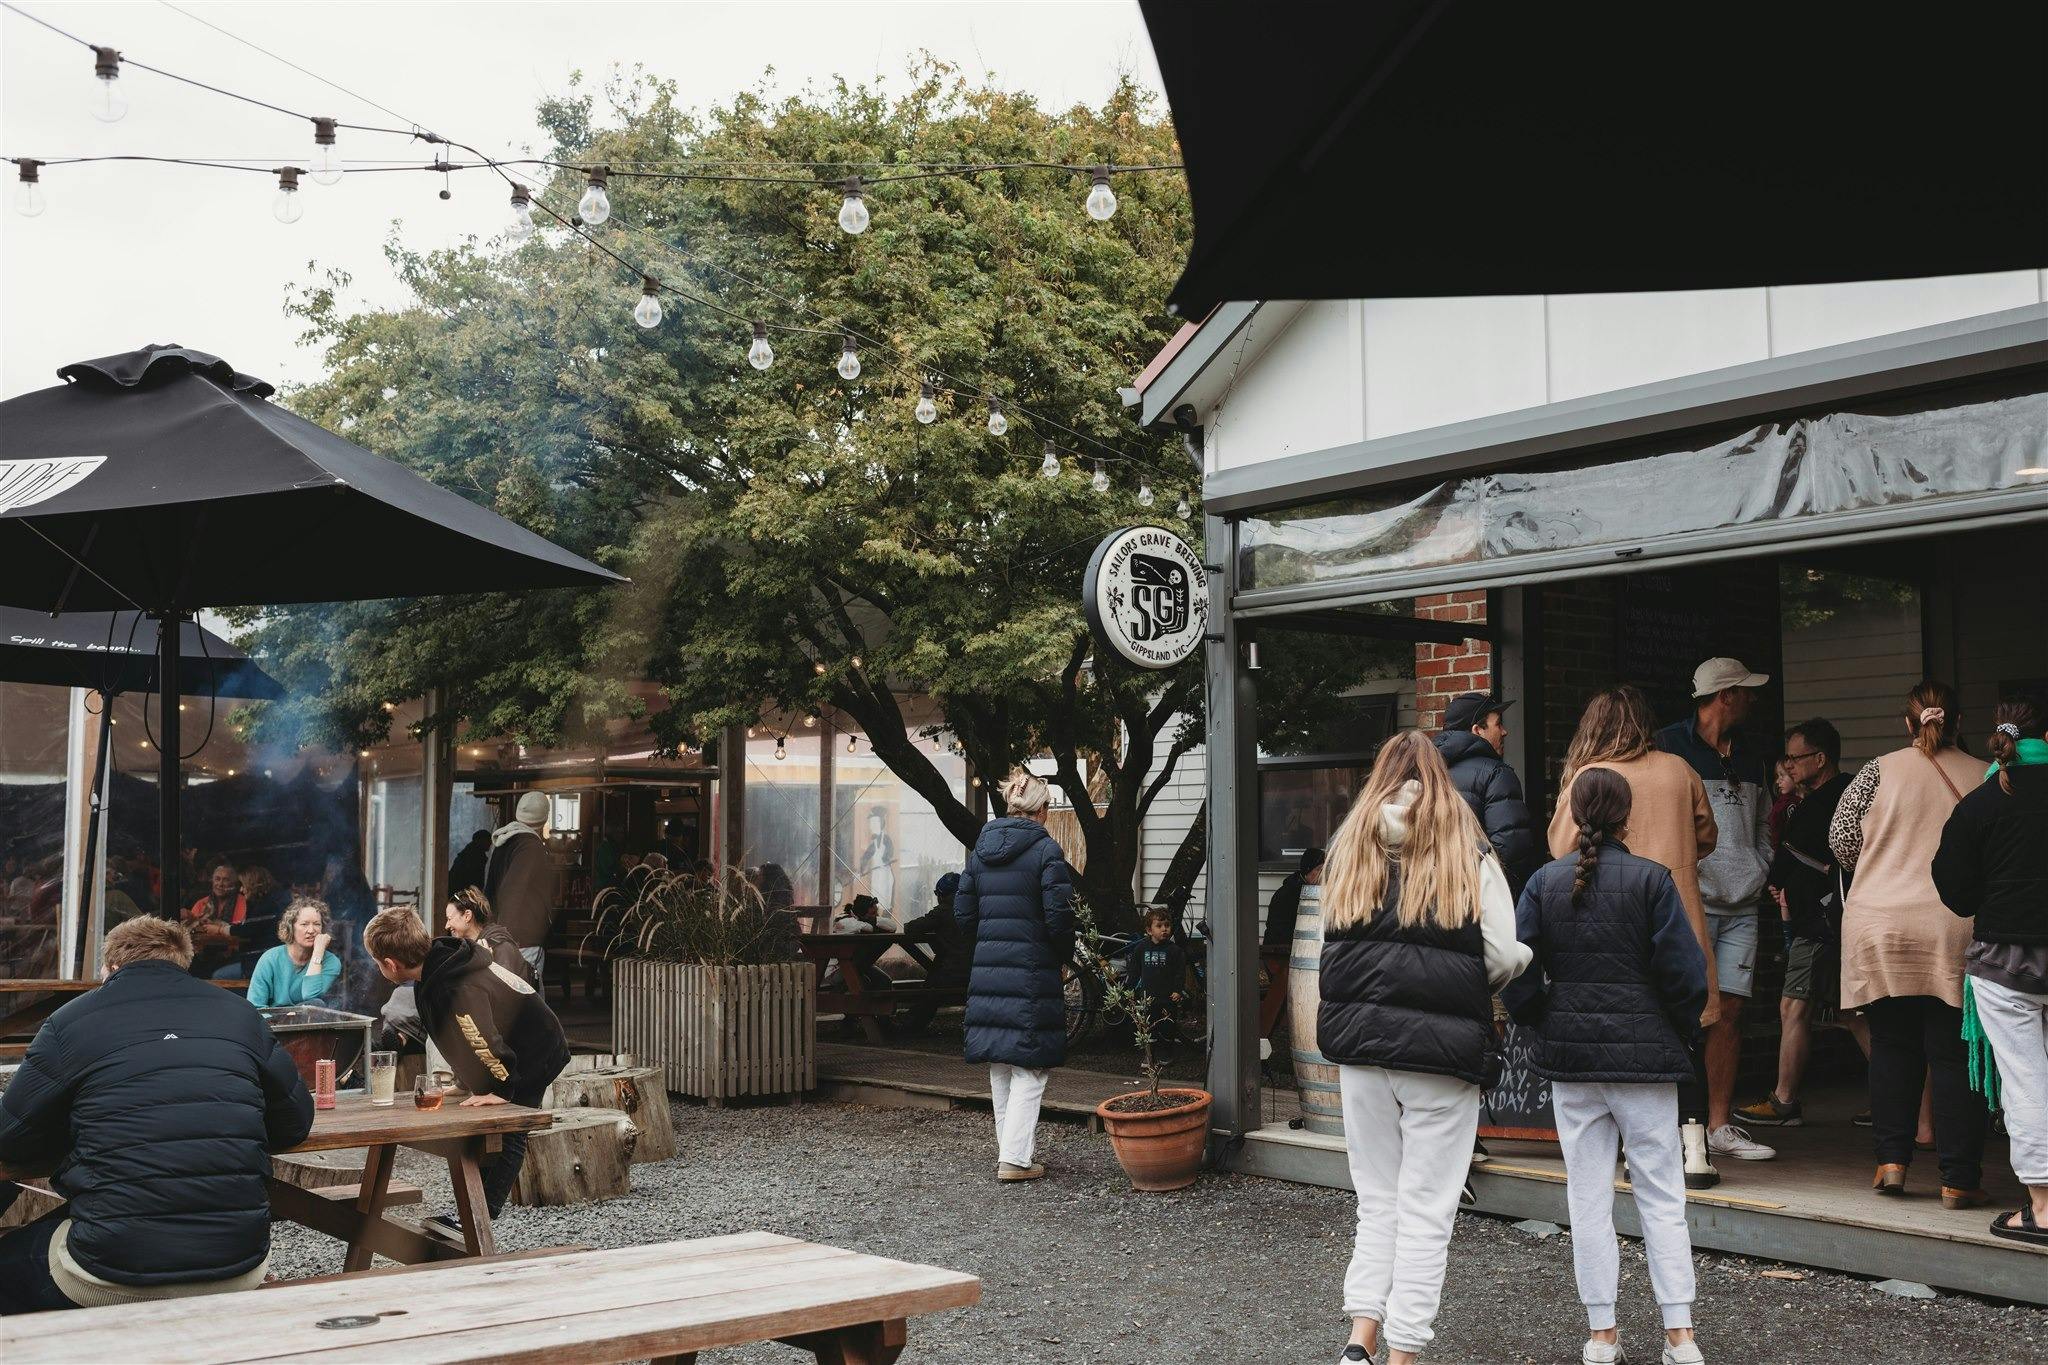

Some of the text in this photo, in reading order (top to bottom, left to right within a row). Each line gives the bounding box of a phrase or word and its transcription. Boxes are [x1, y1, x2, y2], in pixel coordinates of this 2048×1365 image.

[1110, 533, 1207, 588] SAILORS GRAVE BREWING
[1130, 585, 1174, 641] SG
[10, 635, 45, 645] Spill
[51, 640, 78, 648] the
[1130, 641, 1188, 661] GIPPSLAND VIC
